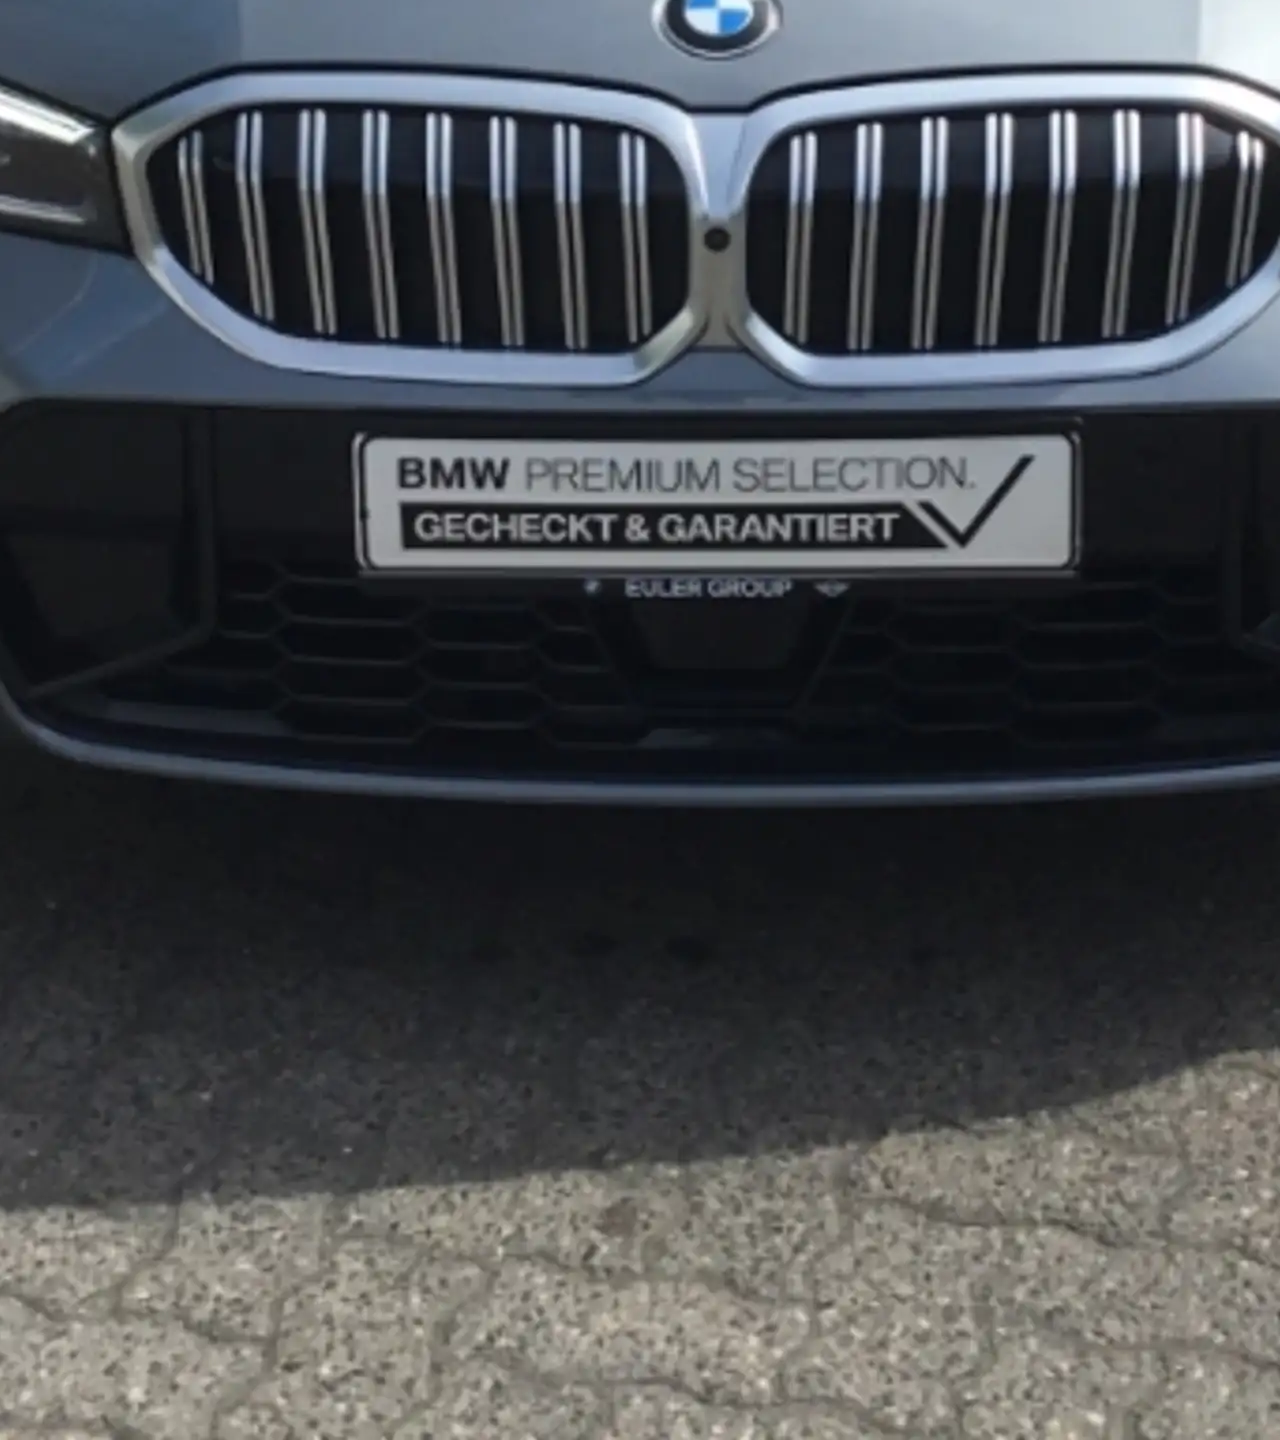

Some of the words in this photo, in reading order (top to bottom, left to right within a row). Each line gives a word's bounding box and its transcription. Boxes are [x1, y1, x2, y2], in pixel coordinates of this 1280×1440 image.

[397, 456, 511, 490] BMW
[524, 456, 721, 493] PREMIUM
[414, 512, 618, 543] GECHECKT
[624, 513, 651, 543] &
[657, 512, 901, 543] GARANTIERT
[624, 578, 704, 598] EULER
[707, 578, 794, 598] GROUP
